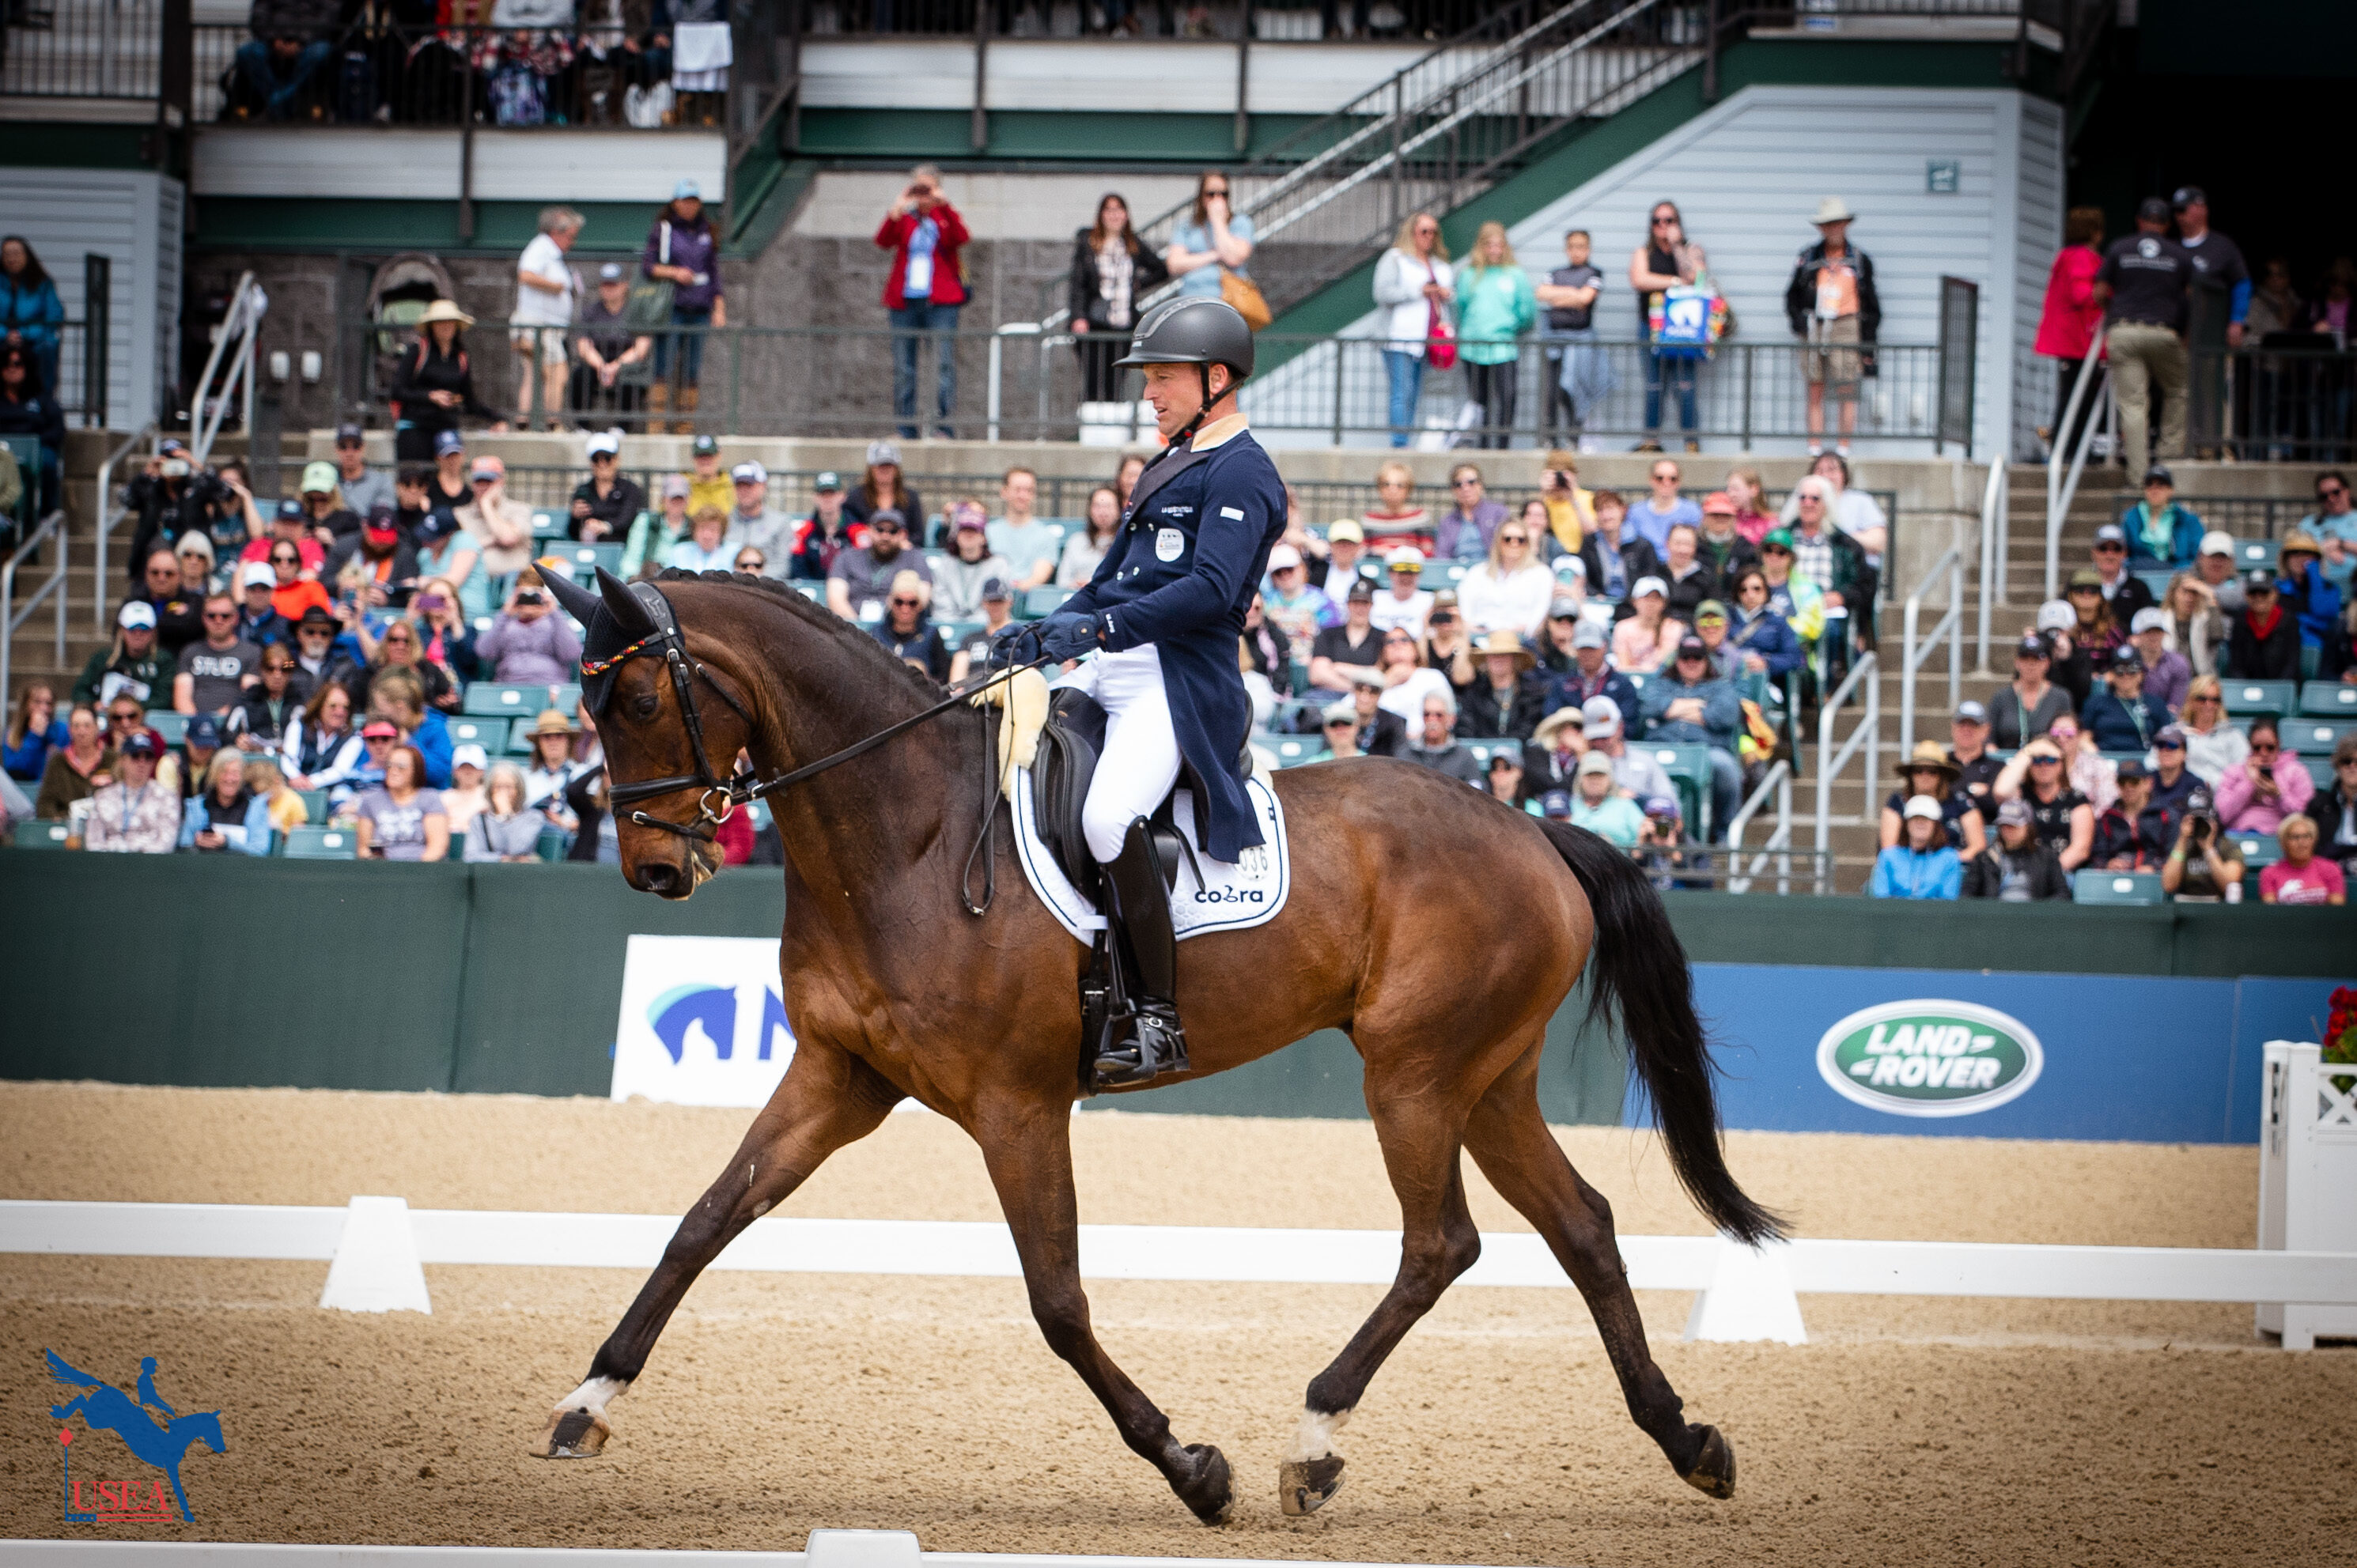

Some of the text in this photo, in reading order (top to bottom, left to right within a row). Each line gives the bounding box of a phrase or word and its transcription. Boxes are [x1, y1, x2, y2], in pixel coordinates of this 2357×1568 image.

[191, 656, 241, 678] STUD
[1194, 885, 1263, 903] cobra
[1864, 1023, 1973, 1057] LAND
[1869, 1055, 2002, 1089] ROVER
